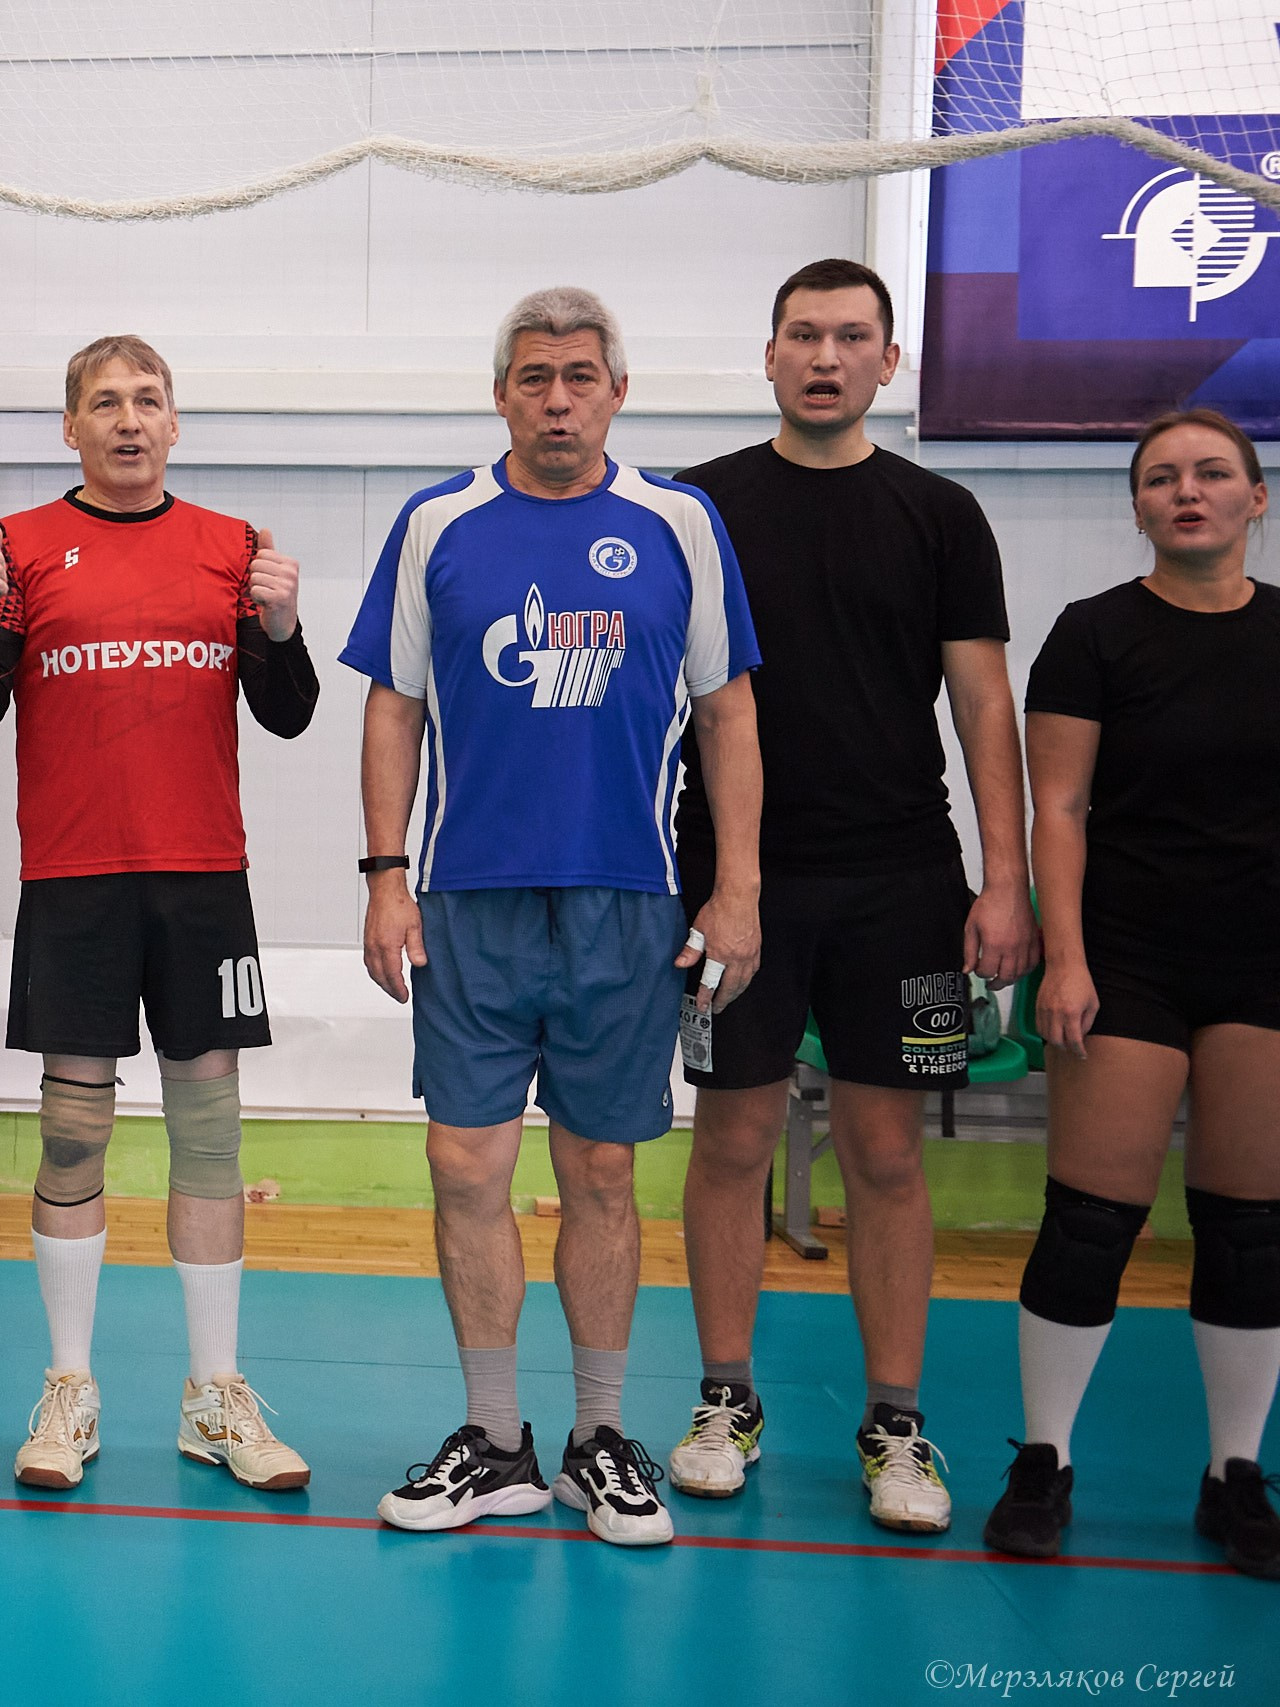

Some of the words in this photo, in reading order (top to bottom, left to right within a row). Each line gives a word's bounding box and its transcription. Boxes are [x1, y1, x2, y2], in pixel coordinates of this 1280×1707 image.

[547, 610, 626, 650] ЮГРА
[217, 955, 264, 1018] 10
[930, 1010, 957, 1028] 001
[908, 1064, 919, 1074] &
